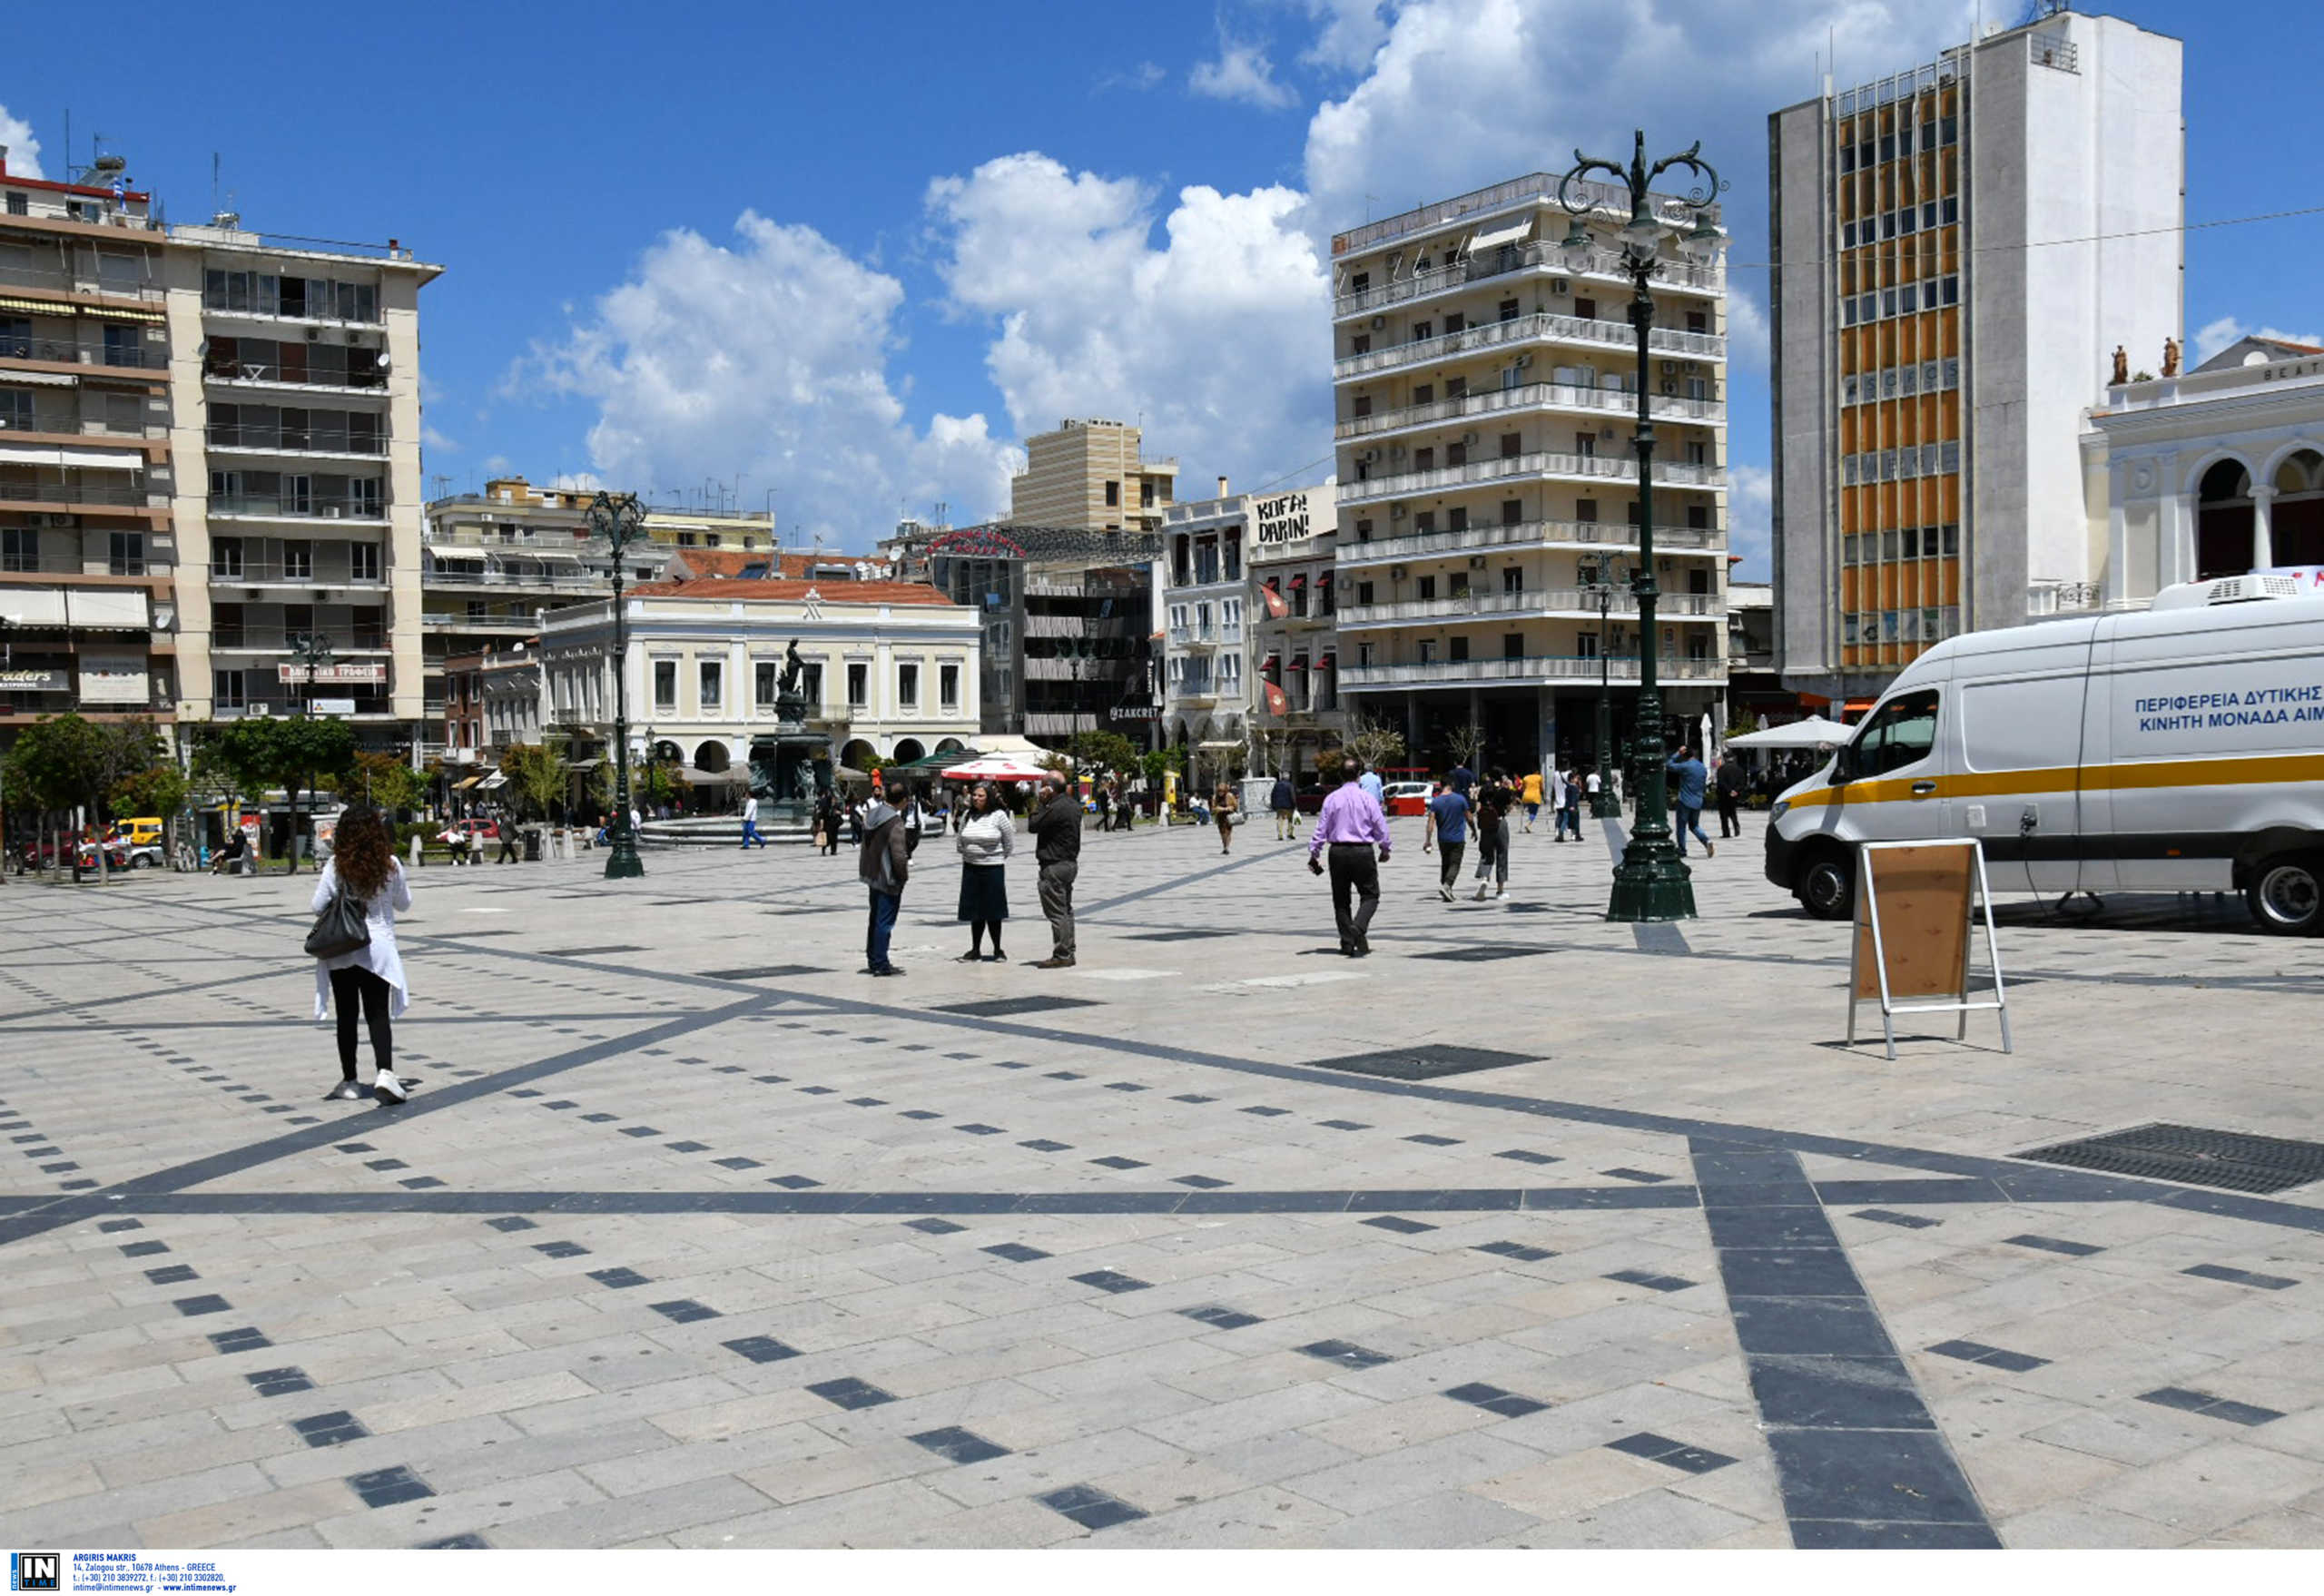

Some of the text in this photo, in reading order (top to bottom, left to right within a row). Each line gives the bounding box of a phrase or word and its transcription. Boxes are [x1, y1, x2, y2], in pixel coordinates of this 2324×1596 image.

[1259, 514, 1309, 542] DARIN!
[2135, 685, 2322, 713] ΠΕΡΙΦΕΡΕΙΑ ΔΥΤΙΚΗΣ
[2140, 714, 2202, 732] ΚΙΝΗΤΗ
[2208, 708, 2289, 727] ΜΟΝΑΔΑ
